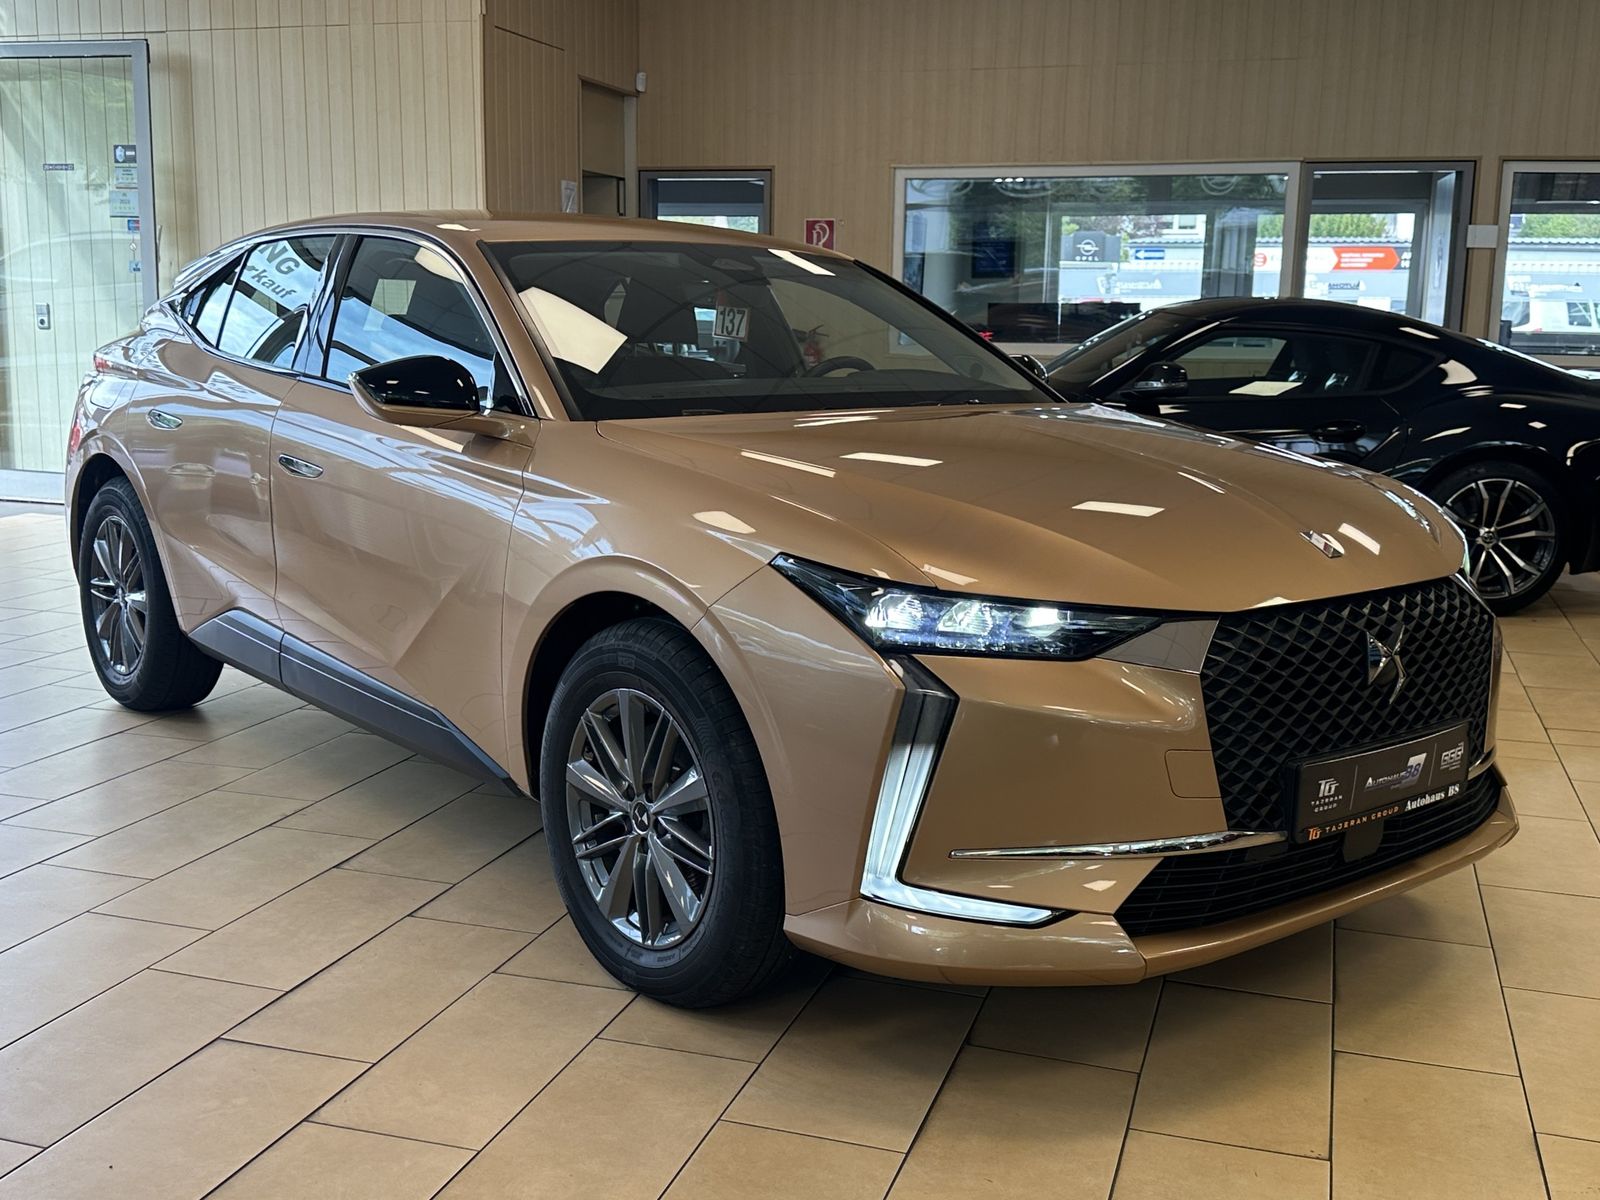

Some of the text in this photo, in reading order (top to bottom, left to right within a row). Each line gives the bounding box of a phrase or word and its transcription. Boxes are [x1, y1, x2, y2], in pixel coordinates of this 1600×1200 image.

[258, 243, 301, 275] NG
[719, 308, 746, 336] 137
[1371, 806, 1399, 820] GROUP
[1405, 792, 1445, 811] Autohaus
